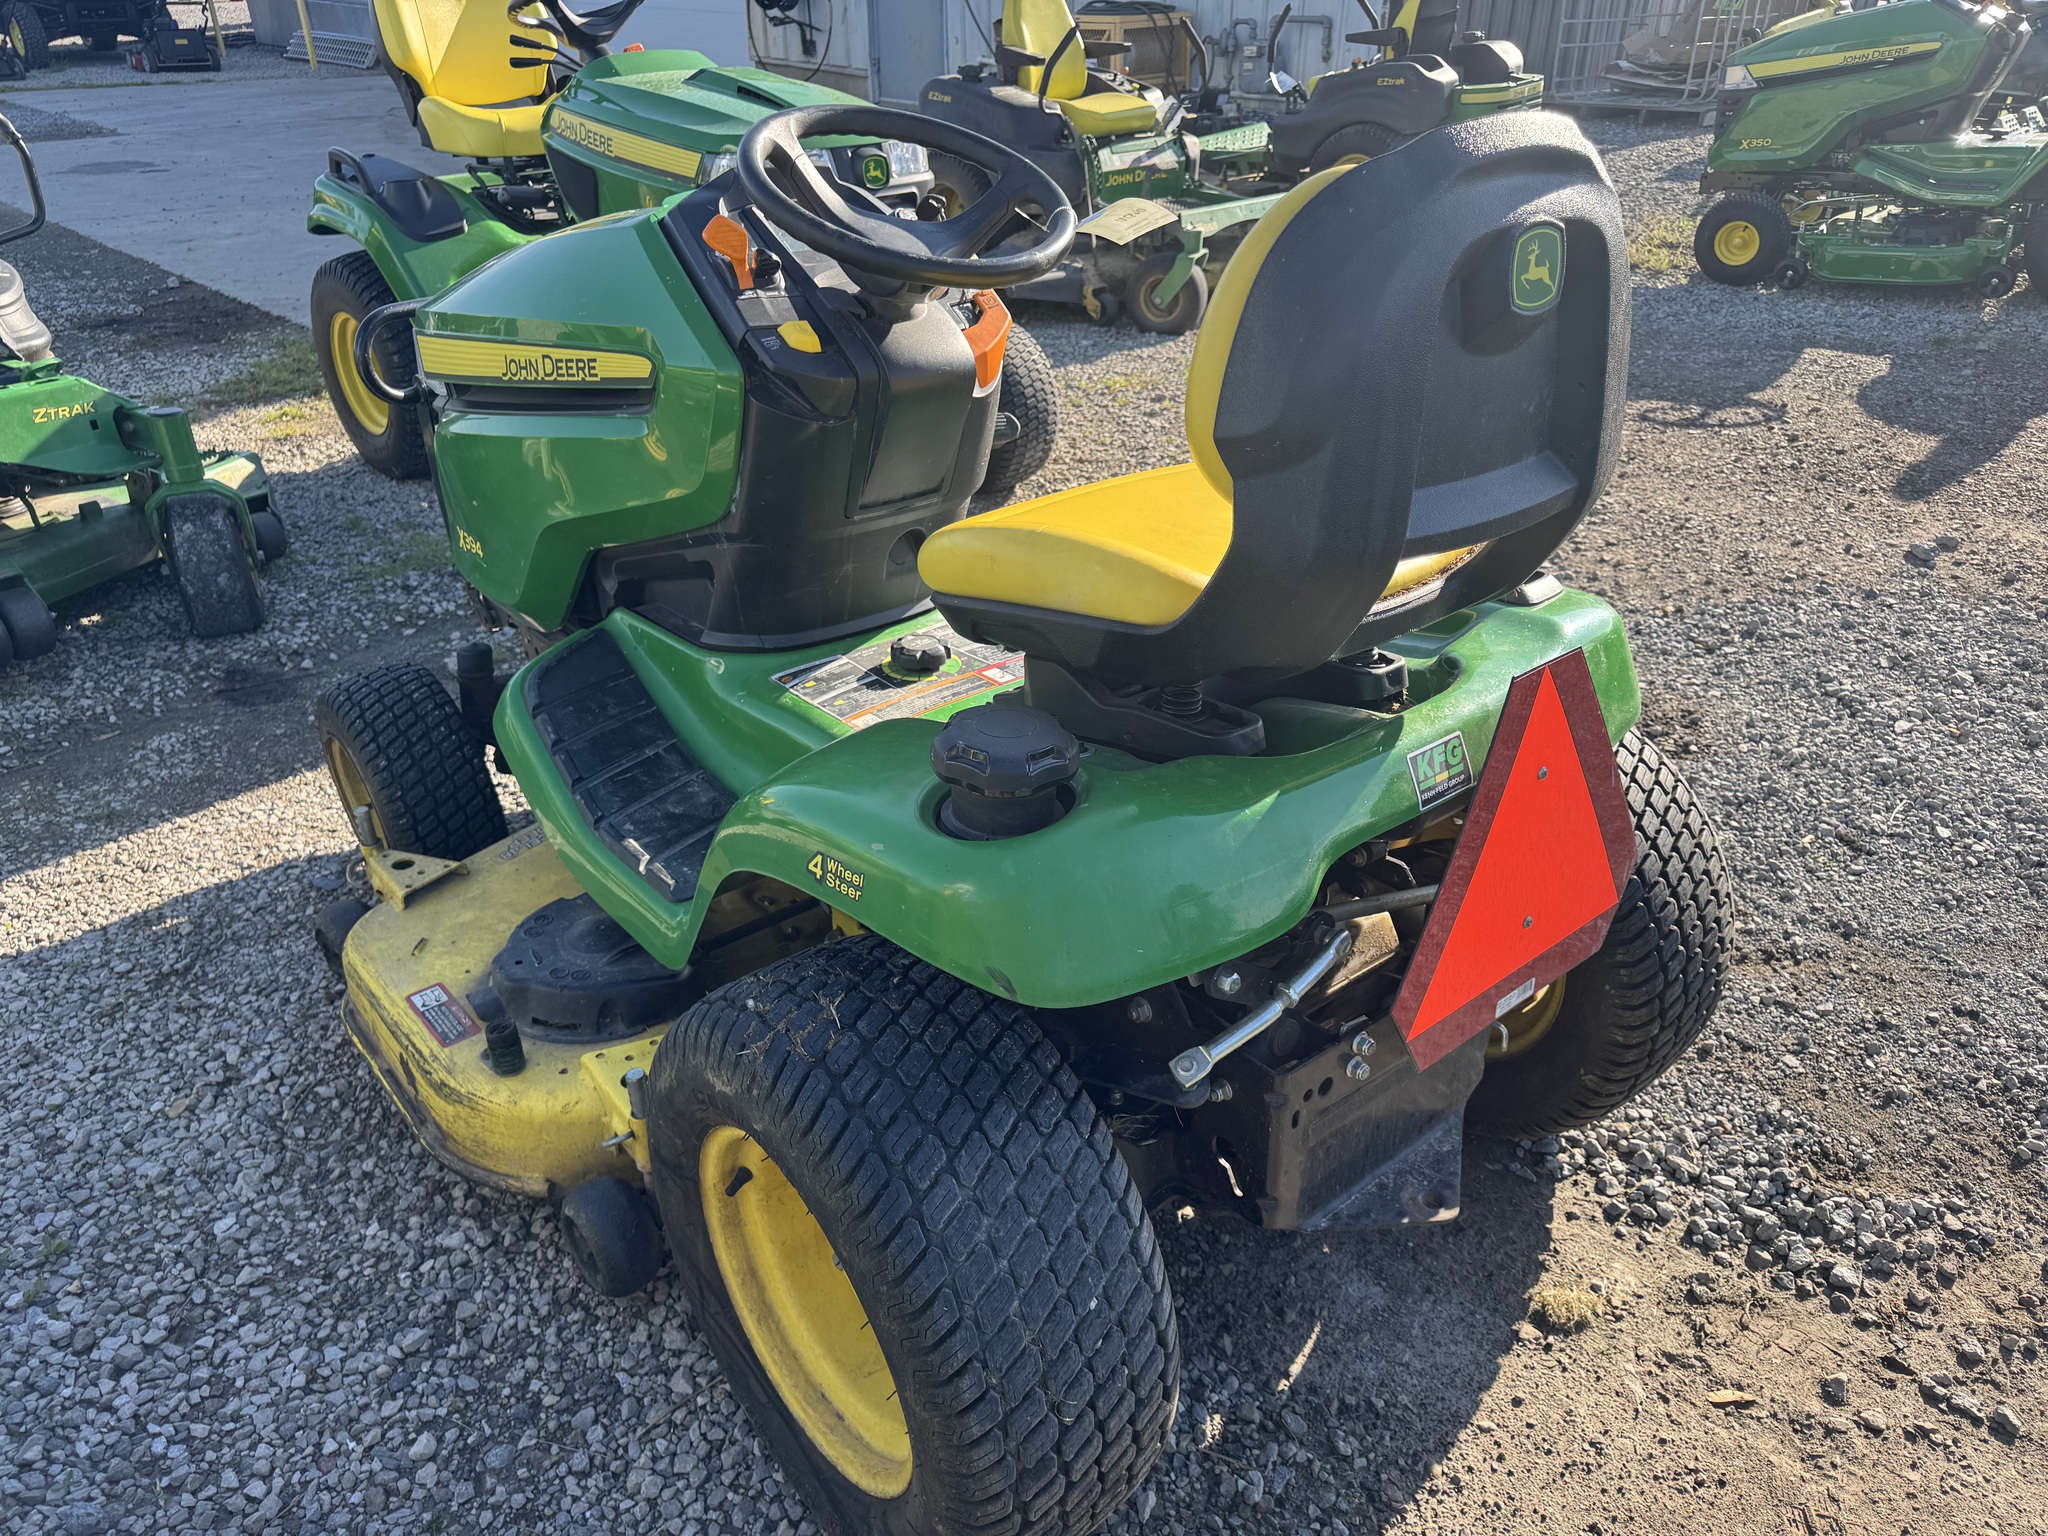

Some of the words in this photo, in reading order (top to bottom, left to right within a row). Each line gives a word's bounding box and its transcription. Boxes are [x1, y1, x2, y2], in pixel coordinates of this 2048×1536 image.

[1839, 53, 1870, 64] JOHN
[1872, 46, 1909, 59] DEERE
[556, 112, 578, 142] JOHN
[579, 122, 614, 154] DEERE
[1738, 138, 1772, 149] X350
[1105, 172, 1134, 187] JOHN
[501, 354, 541, 378] JOHN
[541, 354, 600, 379] DEERE
[33, 401, 96, 424] ZTRAK
[456, 525, 483, 559] X394
[1416, 738, 1463, 782] KFG
[1448, 774, 1466, 788] GROUP
[808, 853, 823, 880] 4
[826, 857, 864, 887] Wheel
[826, 872, 862, 901] Steer
